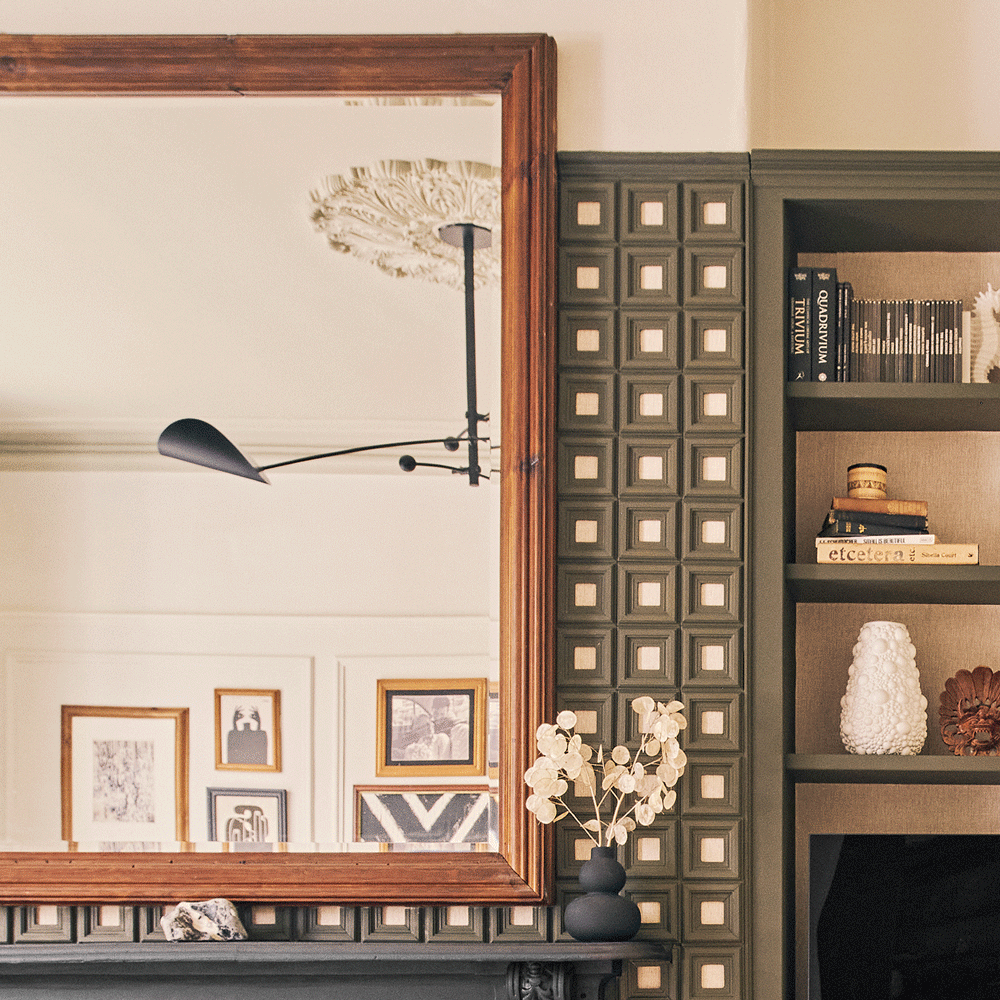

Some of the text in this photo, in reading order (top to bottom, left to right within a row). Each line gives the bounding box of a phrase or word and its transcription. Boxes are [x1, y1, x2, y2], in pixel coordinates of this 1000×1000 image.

[794, 298, 806, 354] TRIVIUM
[817, 290, 828, 364] QUADRIVIUM
[829, 547, 905, 561] etcetera
